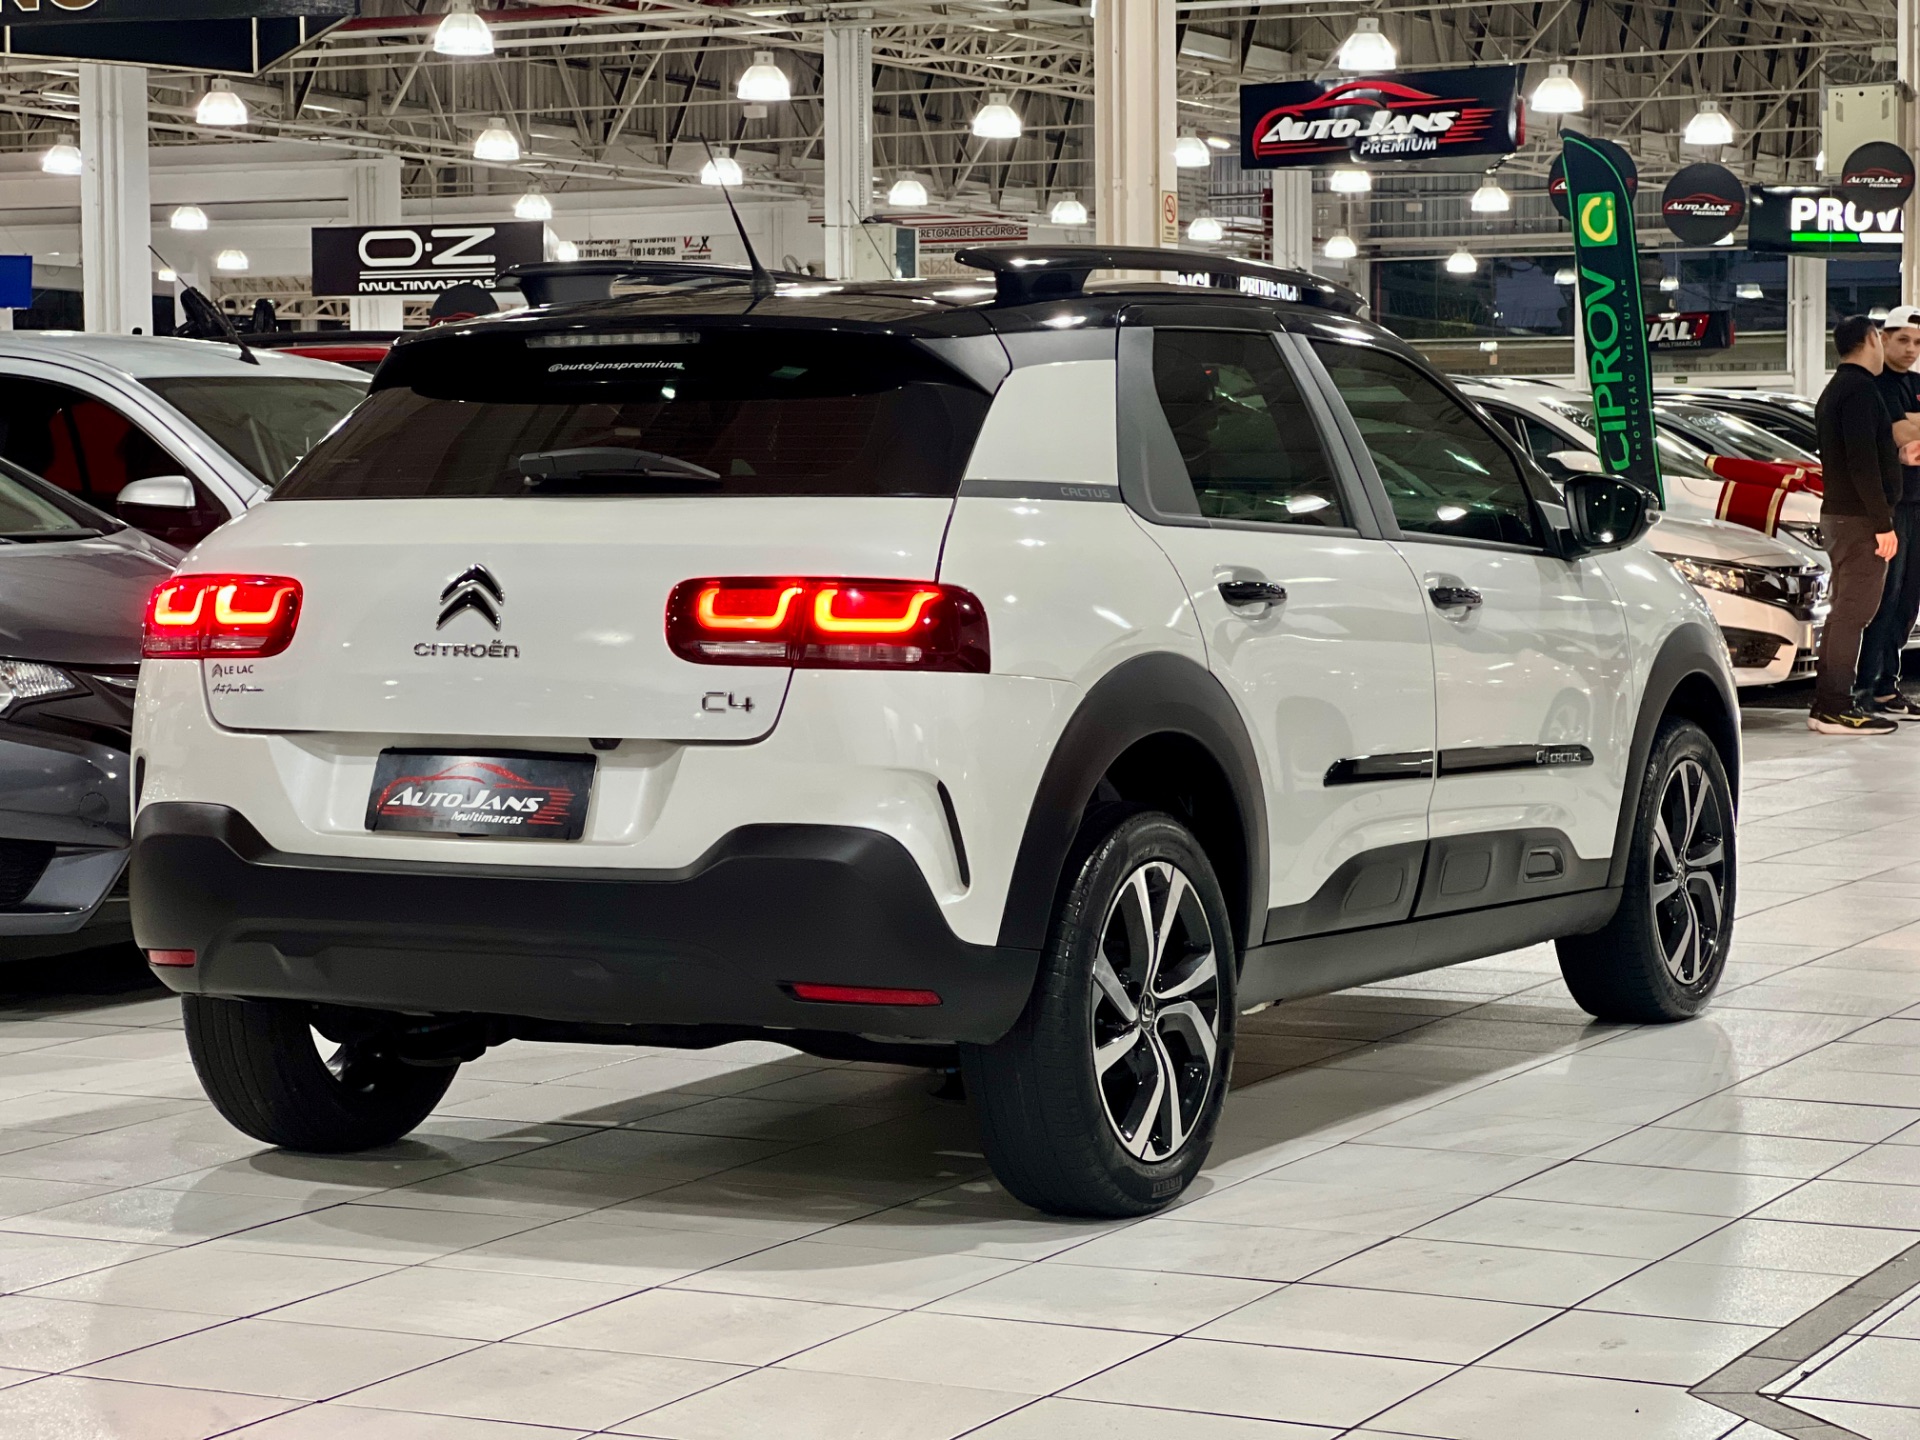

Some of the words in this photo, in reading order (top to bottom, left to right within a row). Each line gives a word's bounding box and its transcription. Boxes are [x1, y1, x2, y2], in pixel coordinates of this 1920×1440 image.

[1359, 136, 1437, 155] PREMIUM
[1791, 197, 1904, 232] PROV
[960, 227, 972, 236] DE
[975, 225, 1020, 236] SEGUROS
[1620, 278, 1634, 362] VEICULAR
[1658, 340, 1702, 348] MULTIMARCAS
[548, 360, 684, 373] @autojanspremium
[1581, 265, 1630, 470] CIPROV
[1628, 373, 1642, 461] PROTEÇÃO
[1060, 486, 1111, 499] CACTUS
[224, 666, 234, 675] LE
[236, 664, 254, 674] LAC
[701, 691, 755, 713] C4
[450, 810, 524, 825] Multimarcas
